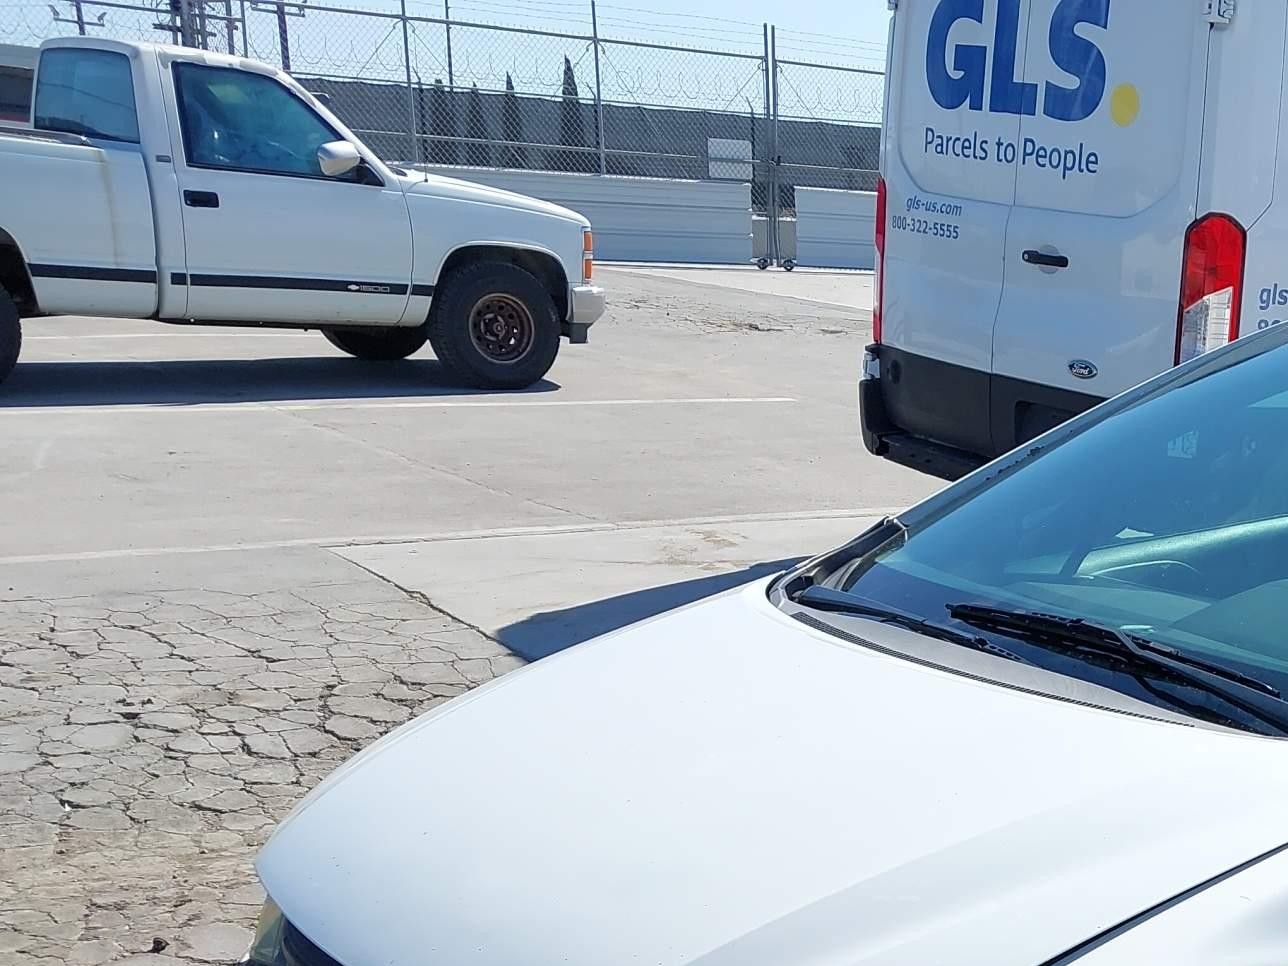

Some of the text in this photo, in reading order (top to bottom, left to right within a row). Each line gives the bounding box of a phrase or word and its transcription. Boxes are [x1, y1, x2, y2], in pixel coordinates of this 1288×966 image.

[924, 127, 1099, 180] Parcels to People
[906, 195, 963, 217] gls-us.com
[891, 215, 960, 240] 800-322-5555
